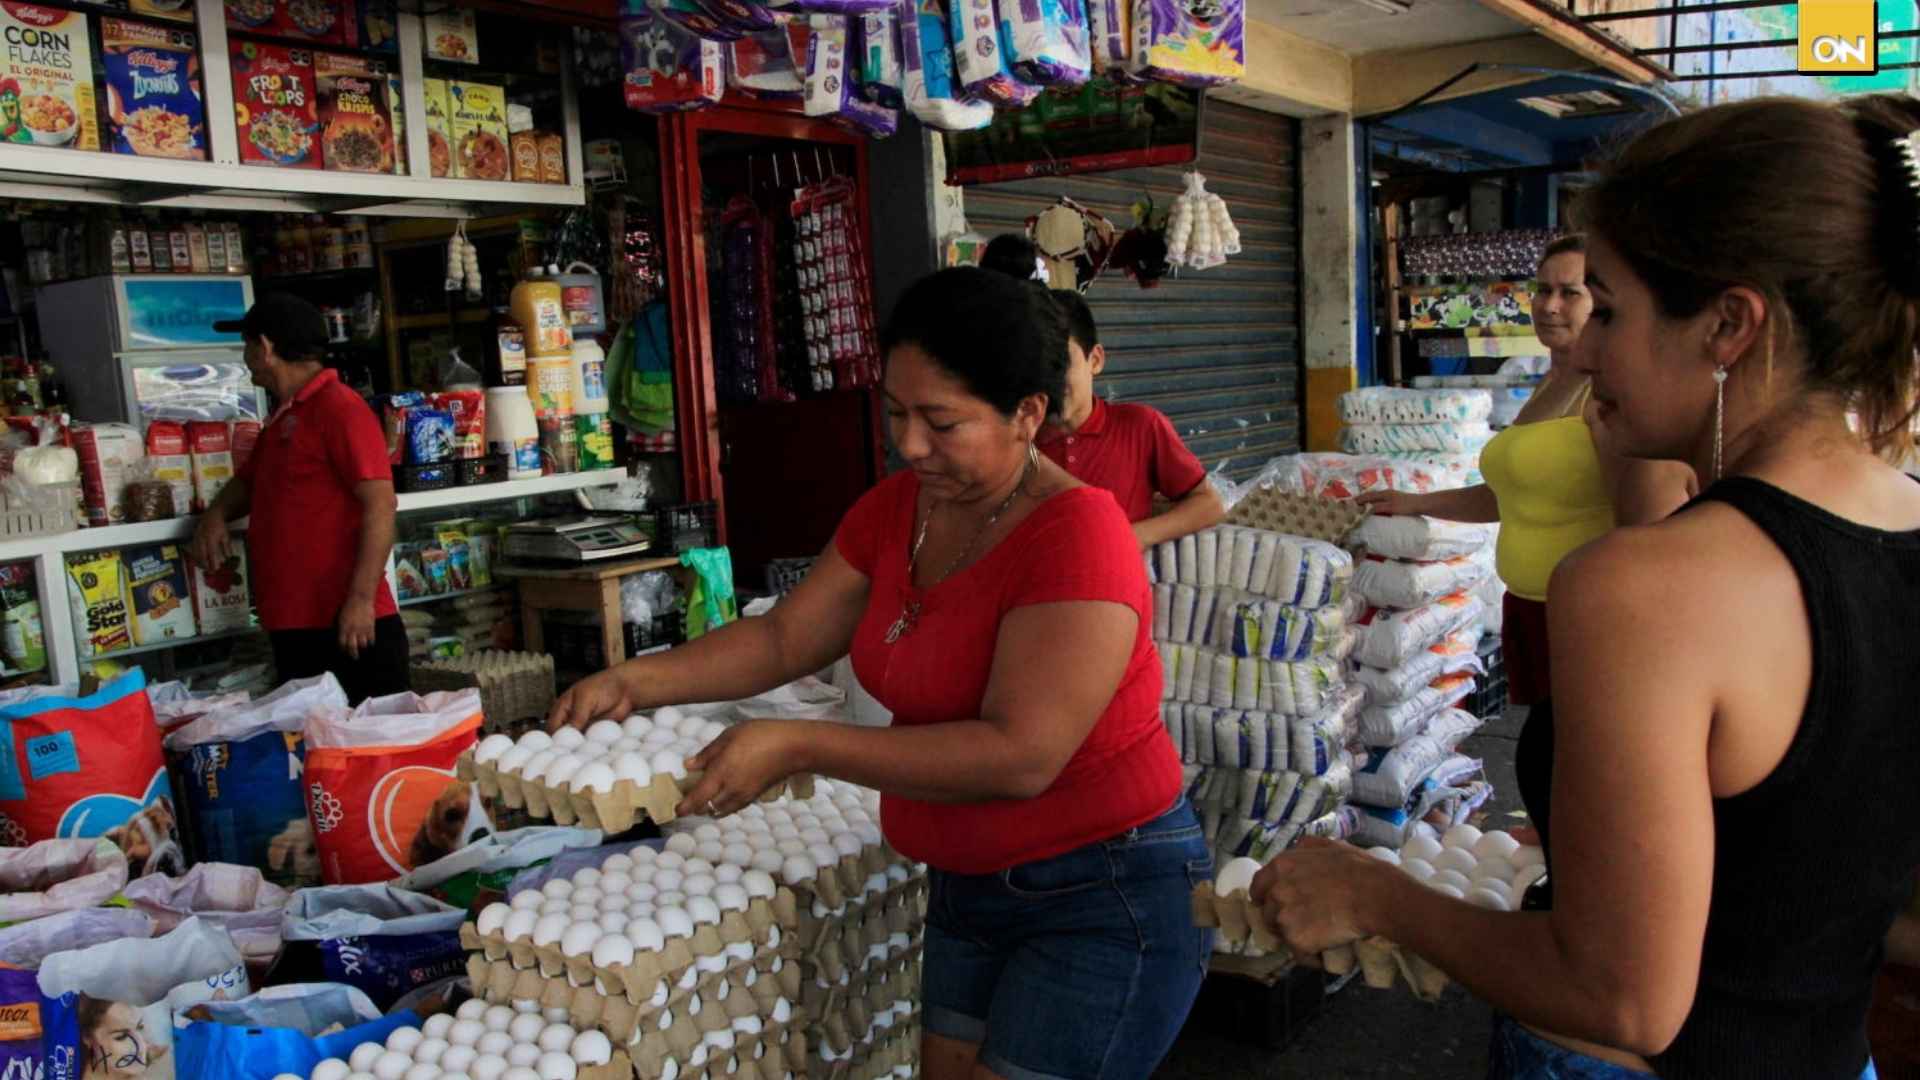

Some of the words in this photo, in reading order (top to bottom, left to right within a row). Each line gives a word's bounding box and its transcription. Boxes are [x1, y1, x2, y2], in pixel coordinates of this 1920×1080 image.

[4, 26, 70, 52] CORN
[9, 45, 72, 69] FLAKES
[9, 64, 22, 74] EL
[24, 67, 75, 82] ORIGINAL
[260, 89, 305, 107] LOOPS
[87, 600, 125, 619] Gold
[87, 611, 127, 632] Star
